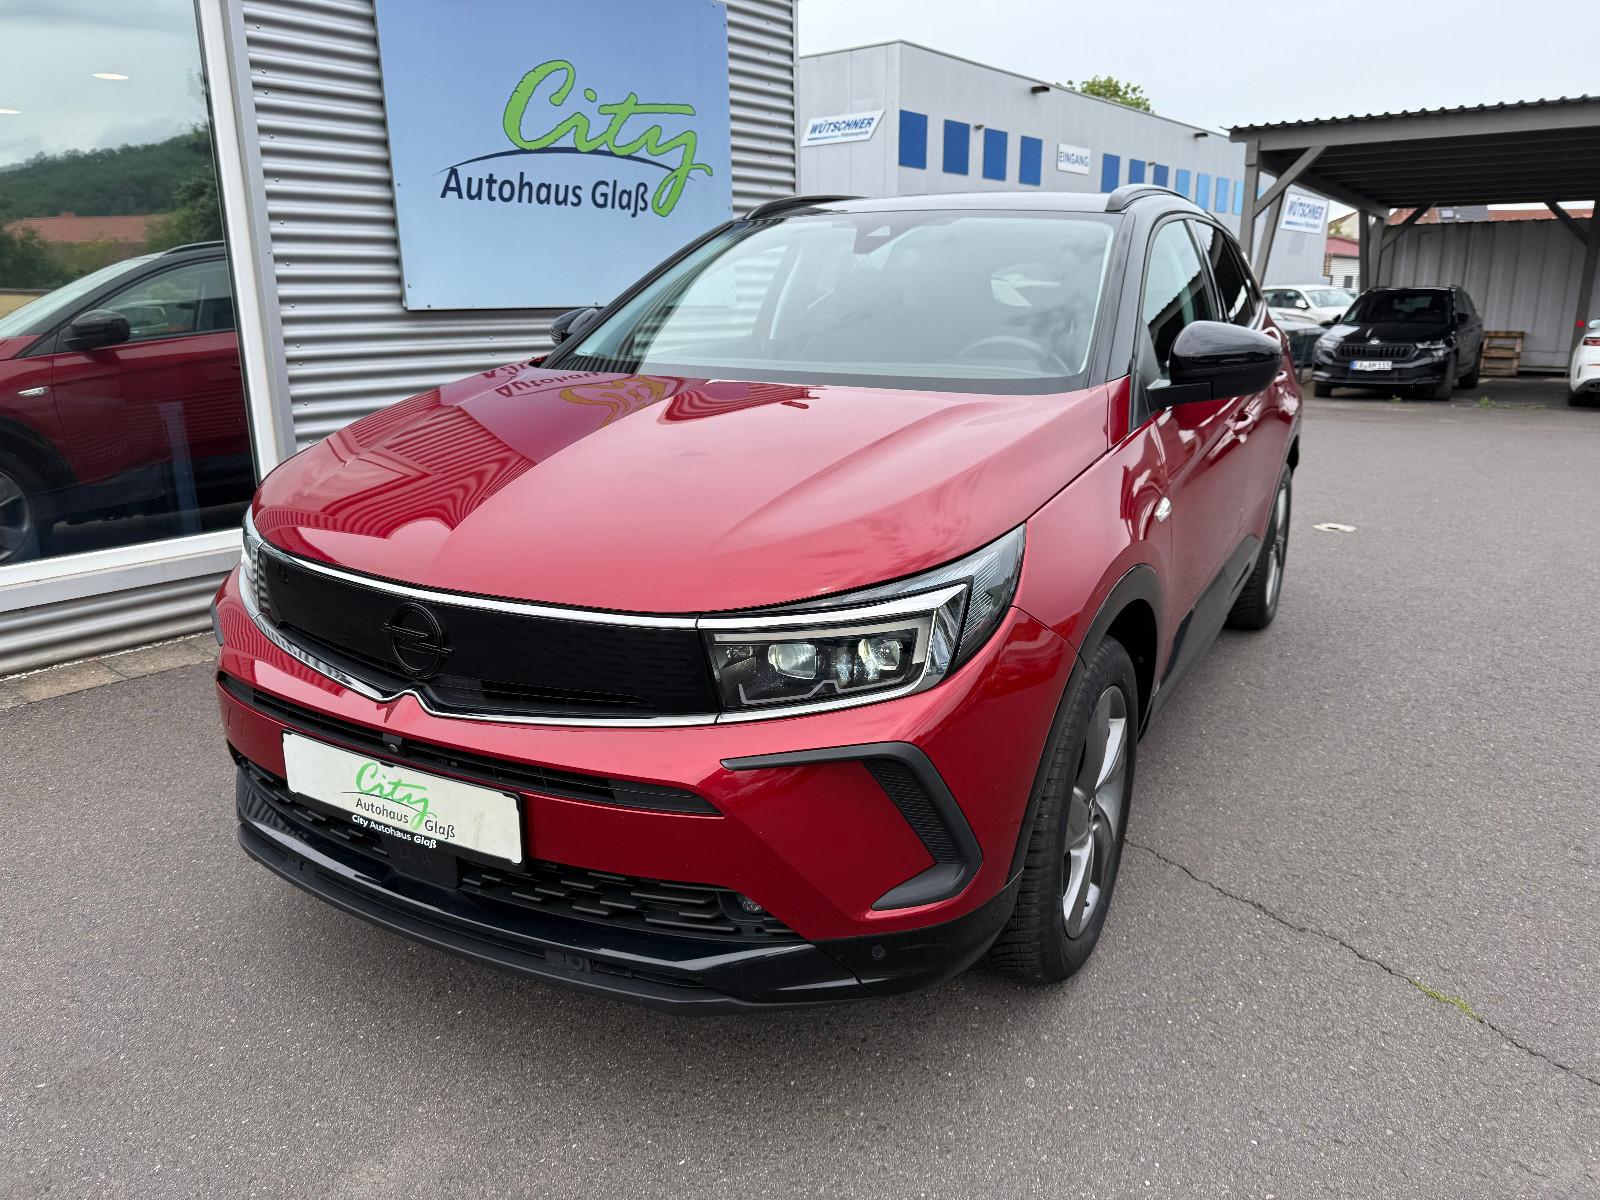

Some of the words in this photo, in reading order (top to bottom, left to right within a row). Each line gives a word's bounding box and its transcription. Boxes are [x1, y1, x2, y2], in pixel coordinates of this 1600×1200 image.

[504, 60, 713, 217] City
[810, 116, 874, 134] WÜTSCHNER
[1059, 151, 1089, 168] EINGANG
[440, 168, 583, 207] Autohaus
[592, 180, 649, 217] Glaß
[356, 762, 438, 830] City
[352, 814, 369, 828] City
[370, 821, 411, 841] Autohaus
[414, 836, 437, 849] Glaß
[356, 798, 409, 824] Autohaus
[425, 820, 456, 839] Glaß
